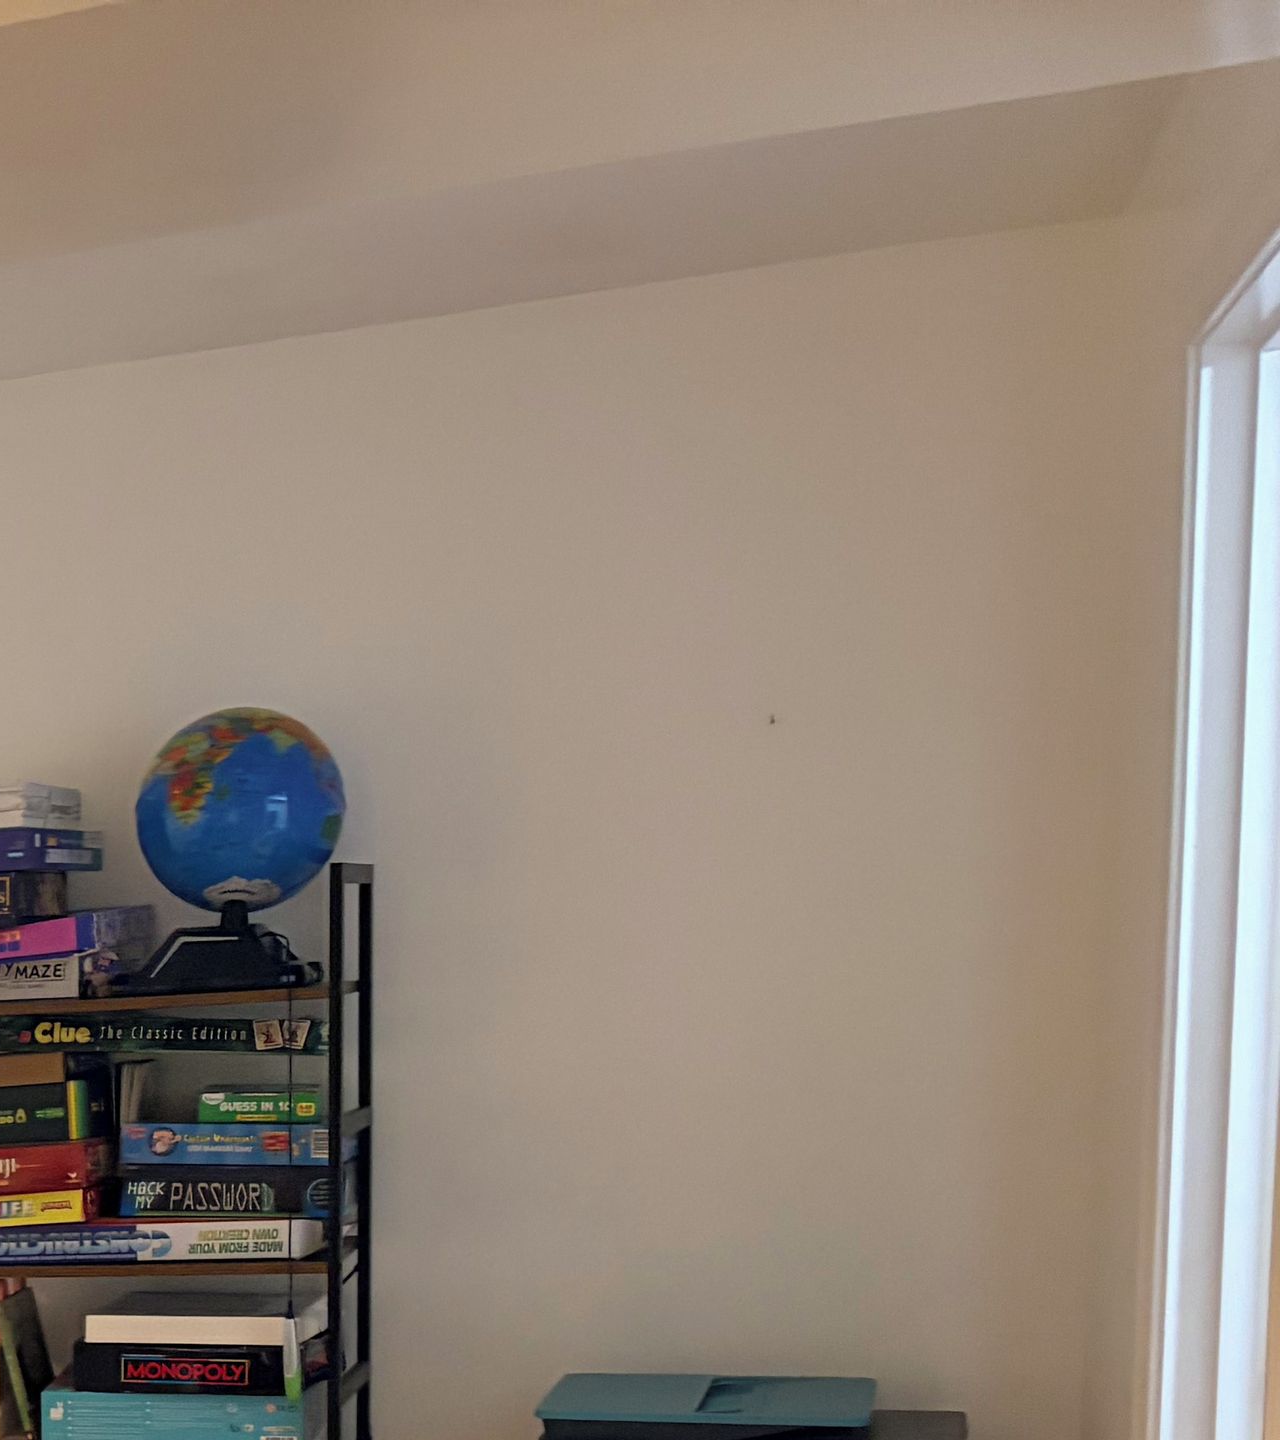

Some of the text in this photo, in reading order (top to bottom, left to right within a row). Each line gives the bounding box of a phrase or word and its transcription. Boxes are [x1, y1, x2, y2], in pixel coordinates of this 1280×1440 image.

[15, 963, 63, 979] MAZE
[34, 1022, 247, 1044] Clue The Classic Edition
[219, 1101, 257, 1112] GUESS
[261, 1101, 274, 1112] IN
[135, 1196, 155, 1209] MY
[170, 1182, 275, 1211] PASSWORD
[251, 1228, 279, 1239] OWN
[188, 1241, 284, 1254] MADE FROM YOUR
[125, 1361, 245, 1382] MONOPOLY
